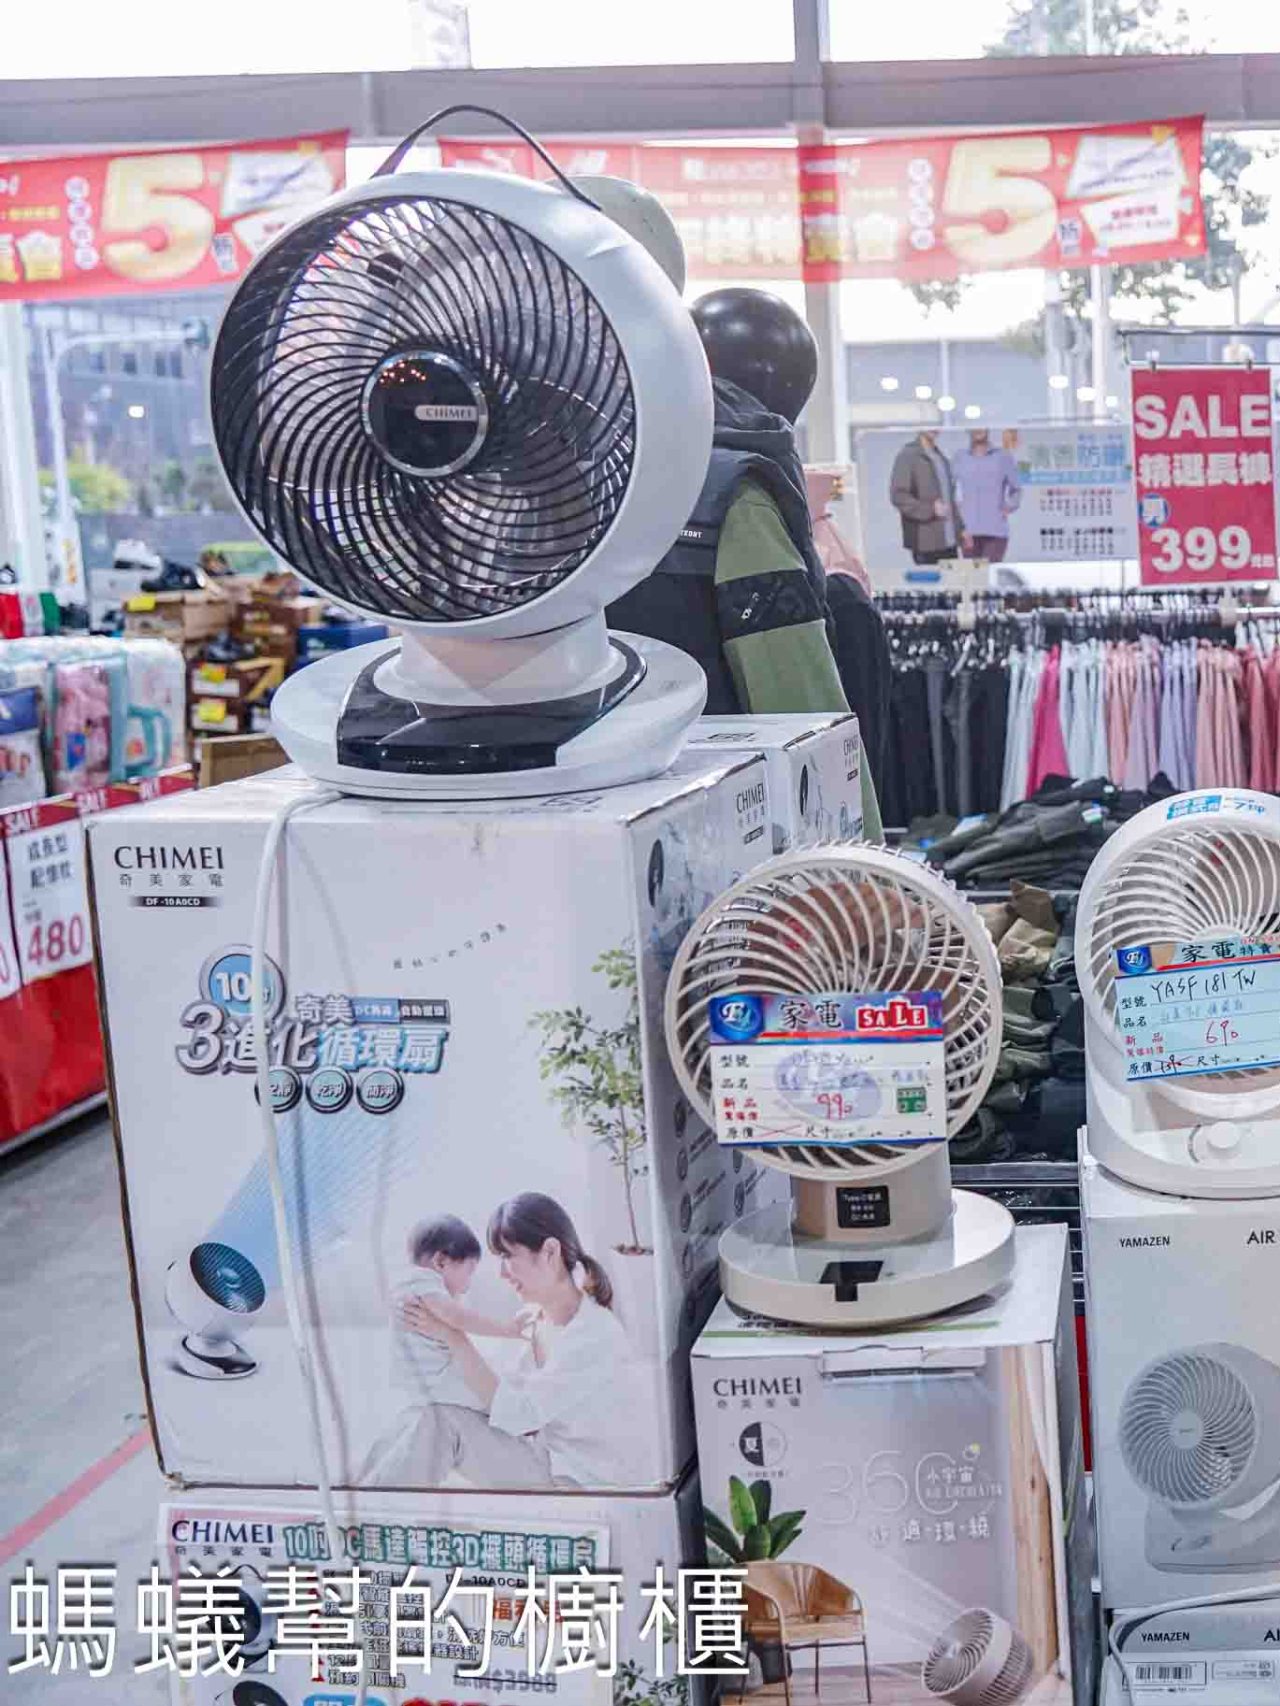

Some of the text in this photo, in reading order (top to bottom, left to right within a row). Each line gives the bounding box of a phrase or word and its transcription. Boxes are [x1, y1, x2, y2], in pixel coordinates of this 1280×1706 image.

[1135, 394, 1271, 439] SALE
[1151, 525, 1252, 572] 399
[113, 846, 225, 871] CHIMEI
[119, 873, 224, 888] 奇美家電
[27, 913, 85, 966] 480
[1181, 940, 1236, 962] 家電
[296, 993, 354, 1025] 奇美
[1121, 994, 1148, 1010] 型號
[780, 1000, 843, 1028] 家電
[860, 1002, 923, 1028] SALE
[1123, 1016, 1148, 1028] 品名
[720, 1055, 750, 1068] 型號
[1128, 1061, 1153, 1075] 原價
[720, 1077, 749, 1089] 品名
[1119, 1236, 1171, 1248] YAMAZEN
[1247, 1230, 1275, 1245] AIR
[713, 1376, 803, 1397] CHIMEI
[172, 1519, 275, 1545] CHIMEI
[1141, 1631, 1191, 1643] YAMAZEN
